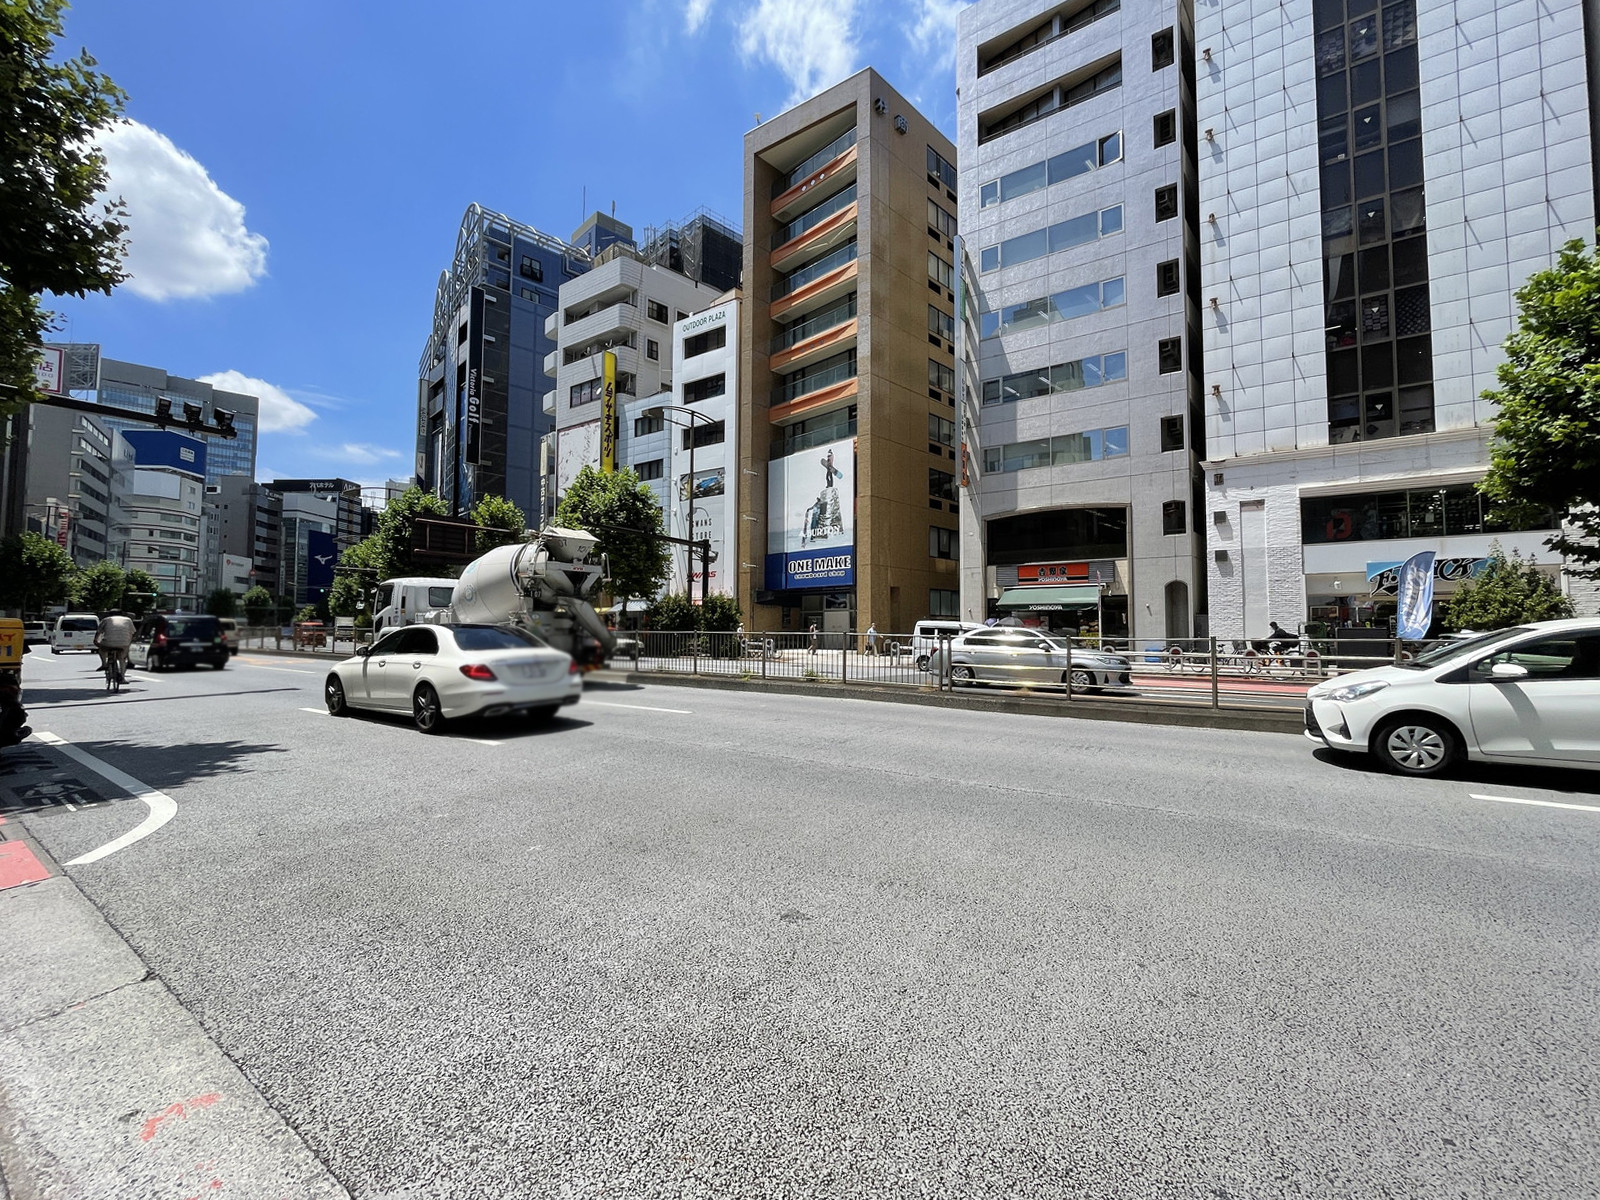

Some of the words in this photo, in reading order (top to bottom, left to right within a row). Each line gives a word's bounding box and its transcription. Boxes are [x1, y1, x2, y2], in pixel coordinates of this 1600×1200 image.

[682, 316, 708, 333] OUTDOOR
[708, 310, 726, 323] PLAZA
[469, 368, 477, 396] Victoria
[468, 396, 480, 424] Golf
[603, 382, 612, 458] ムラサキスポーツ
[692, 531, 712, 540] TORE
[807, 524, 841, 537] BURTON
[788, 558, 813, 574] ONE
[814, 555, 851, 571] MAKE
